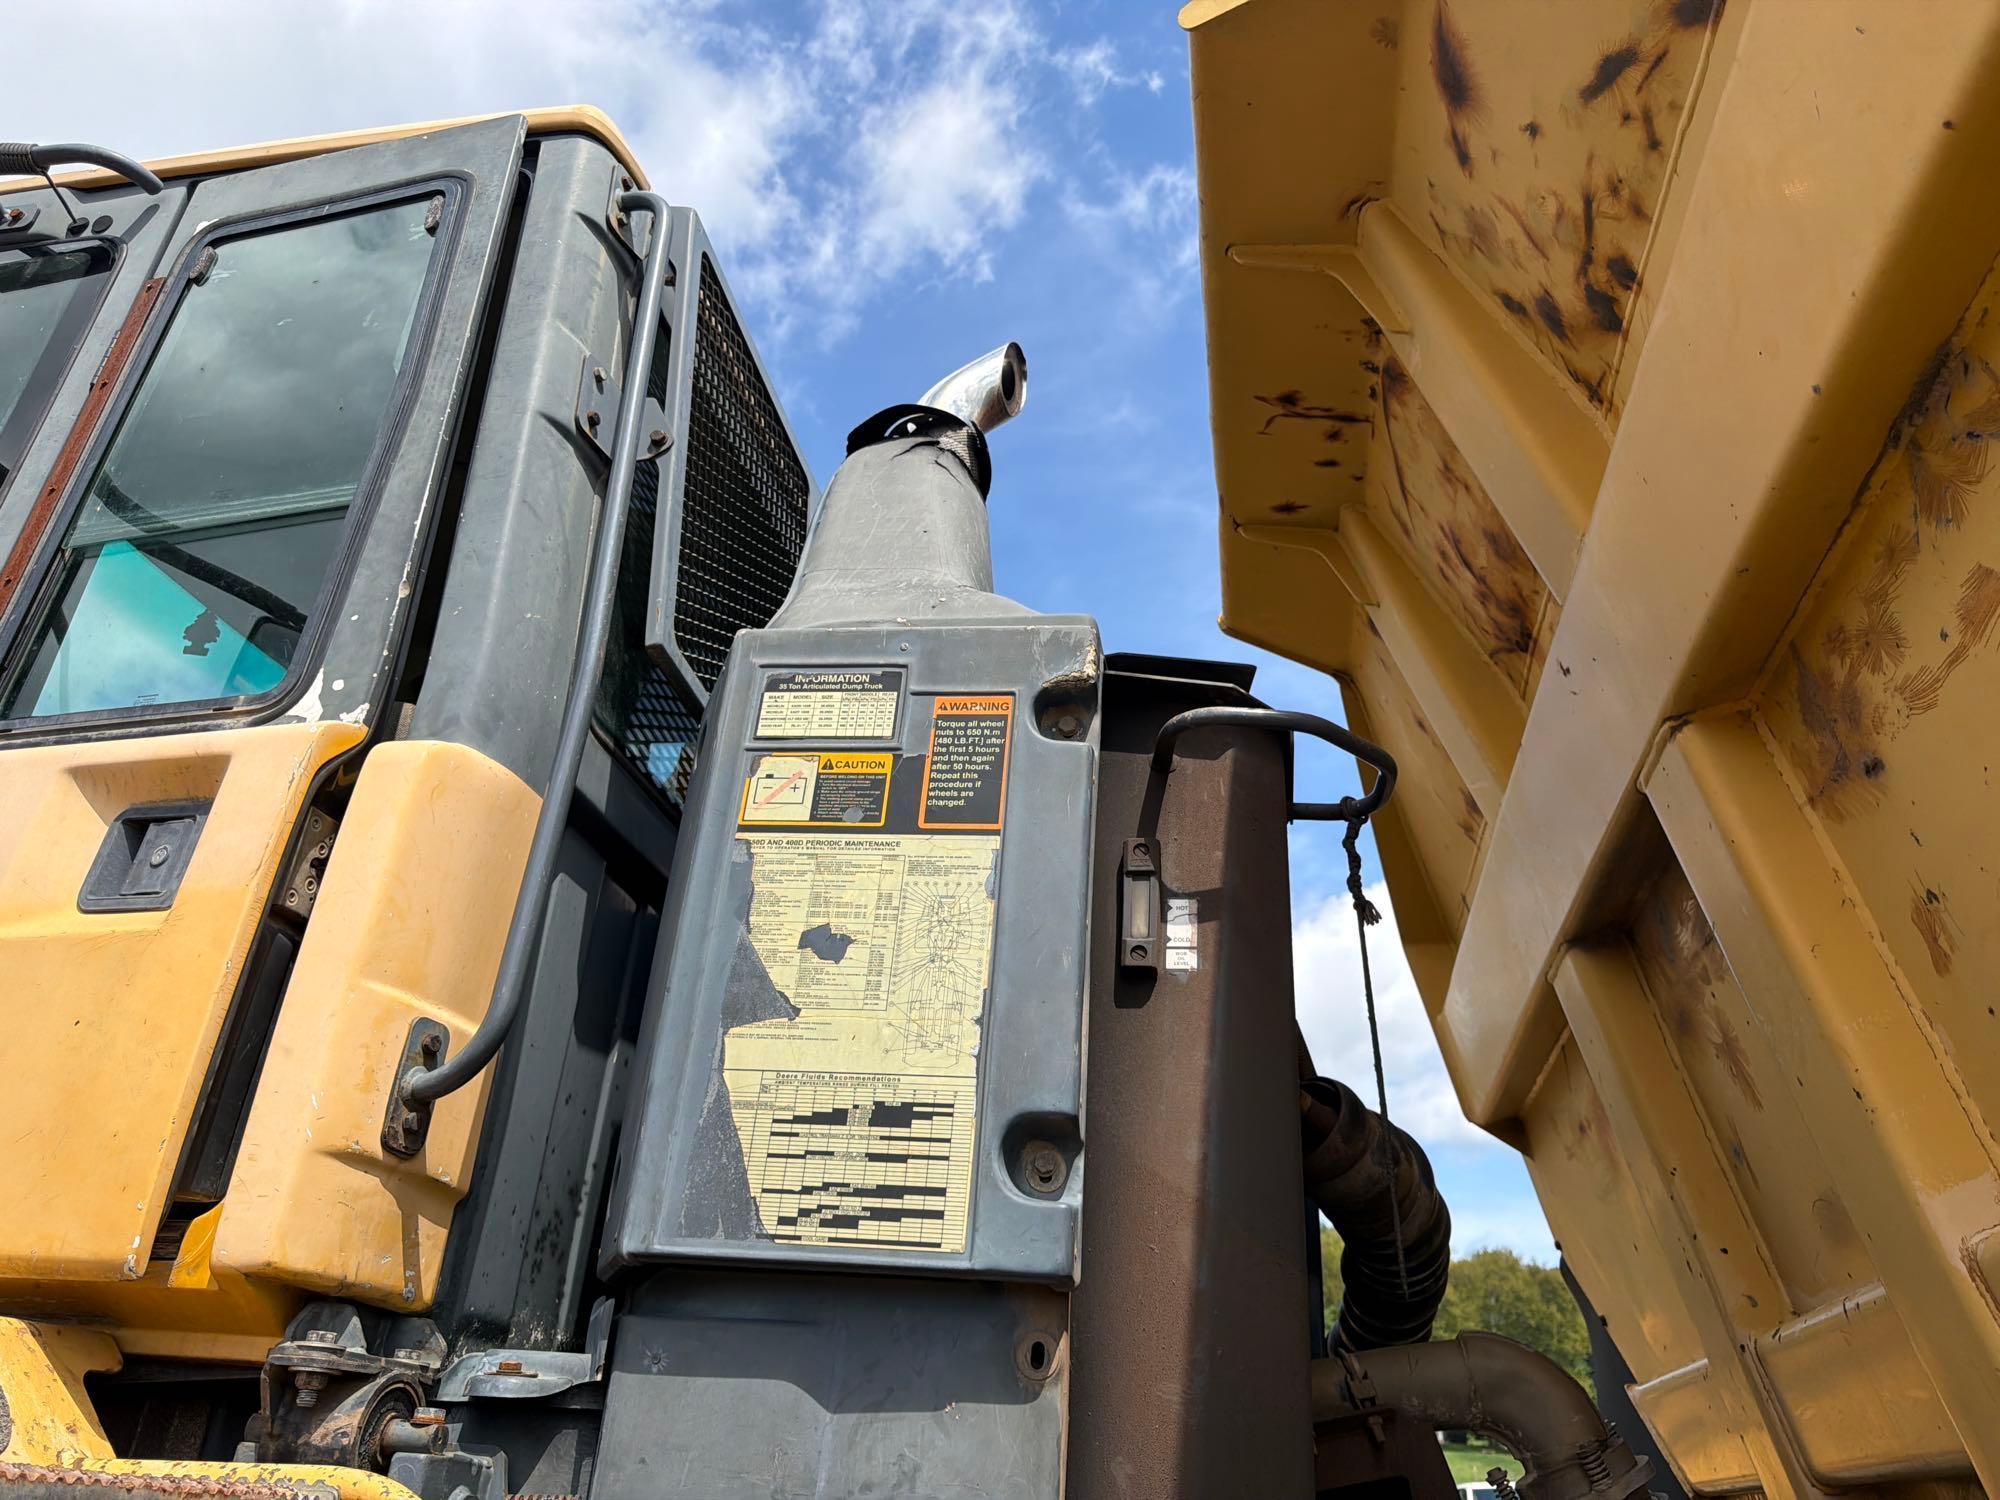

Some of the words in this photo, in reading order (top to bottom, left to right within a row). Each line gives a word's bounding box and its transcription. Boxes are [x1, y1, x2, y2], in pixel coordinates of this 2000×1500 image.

[950, 702, 1009, 711] WARNING
[938, 720, 965, 728] Torque
[835, 761, 885, 769] CAUTION
[927, 799, 966, 807] changed.
[829, 1074, 900, 1082] Recommendations
